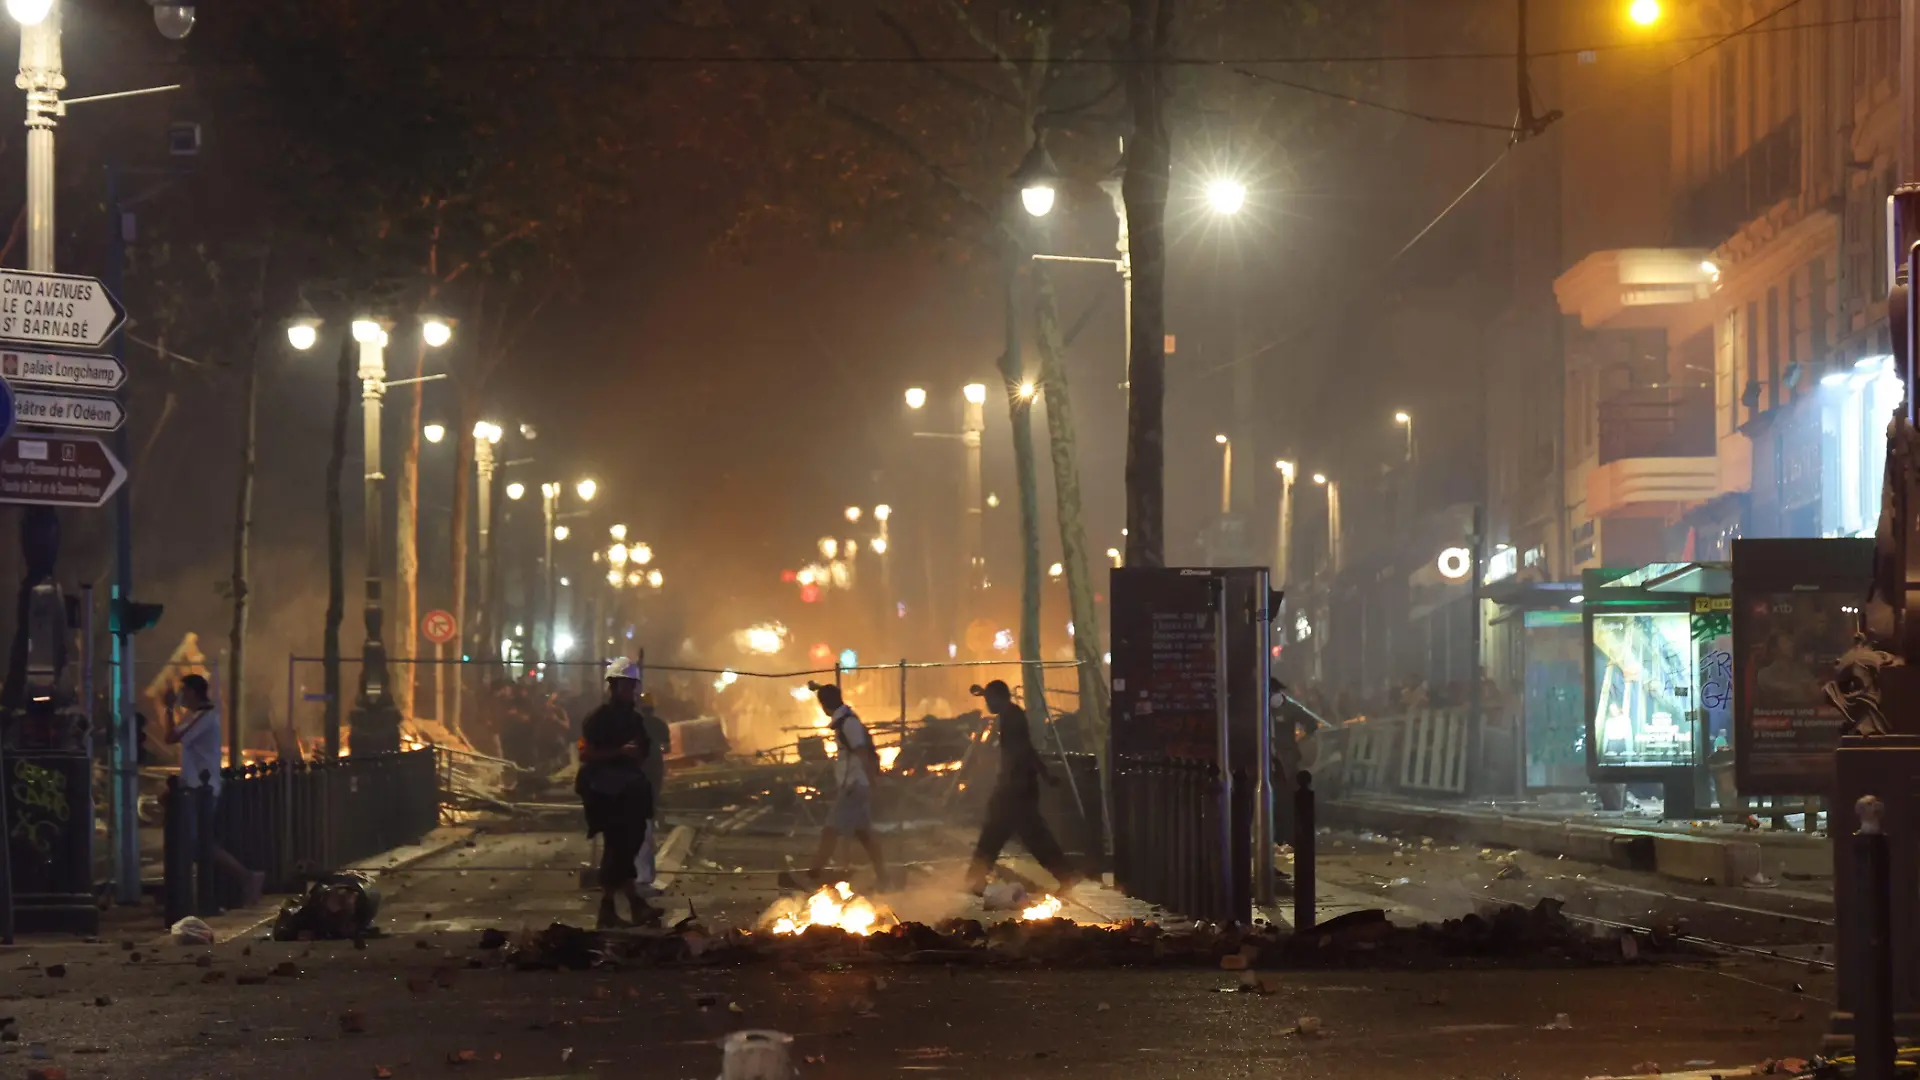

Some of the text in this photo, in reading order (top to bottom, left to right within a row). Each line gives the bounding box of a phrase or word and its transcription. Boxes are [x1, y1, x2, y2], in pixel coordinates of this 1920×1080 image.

[3, 279, 92, 301] CINQ AVENUES
[2, 298, 74, 318] LE CAMAS
[23, 319, 88, 339] BARNABÉ
[22, 359, 114, 384] palais Longchamp
[49, 403, 63, 418] de
[66, 404, 112, 422] l'Odéon
